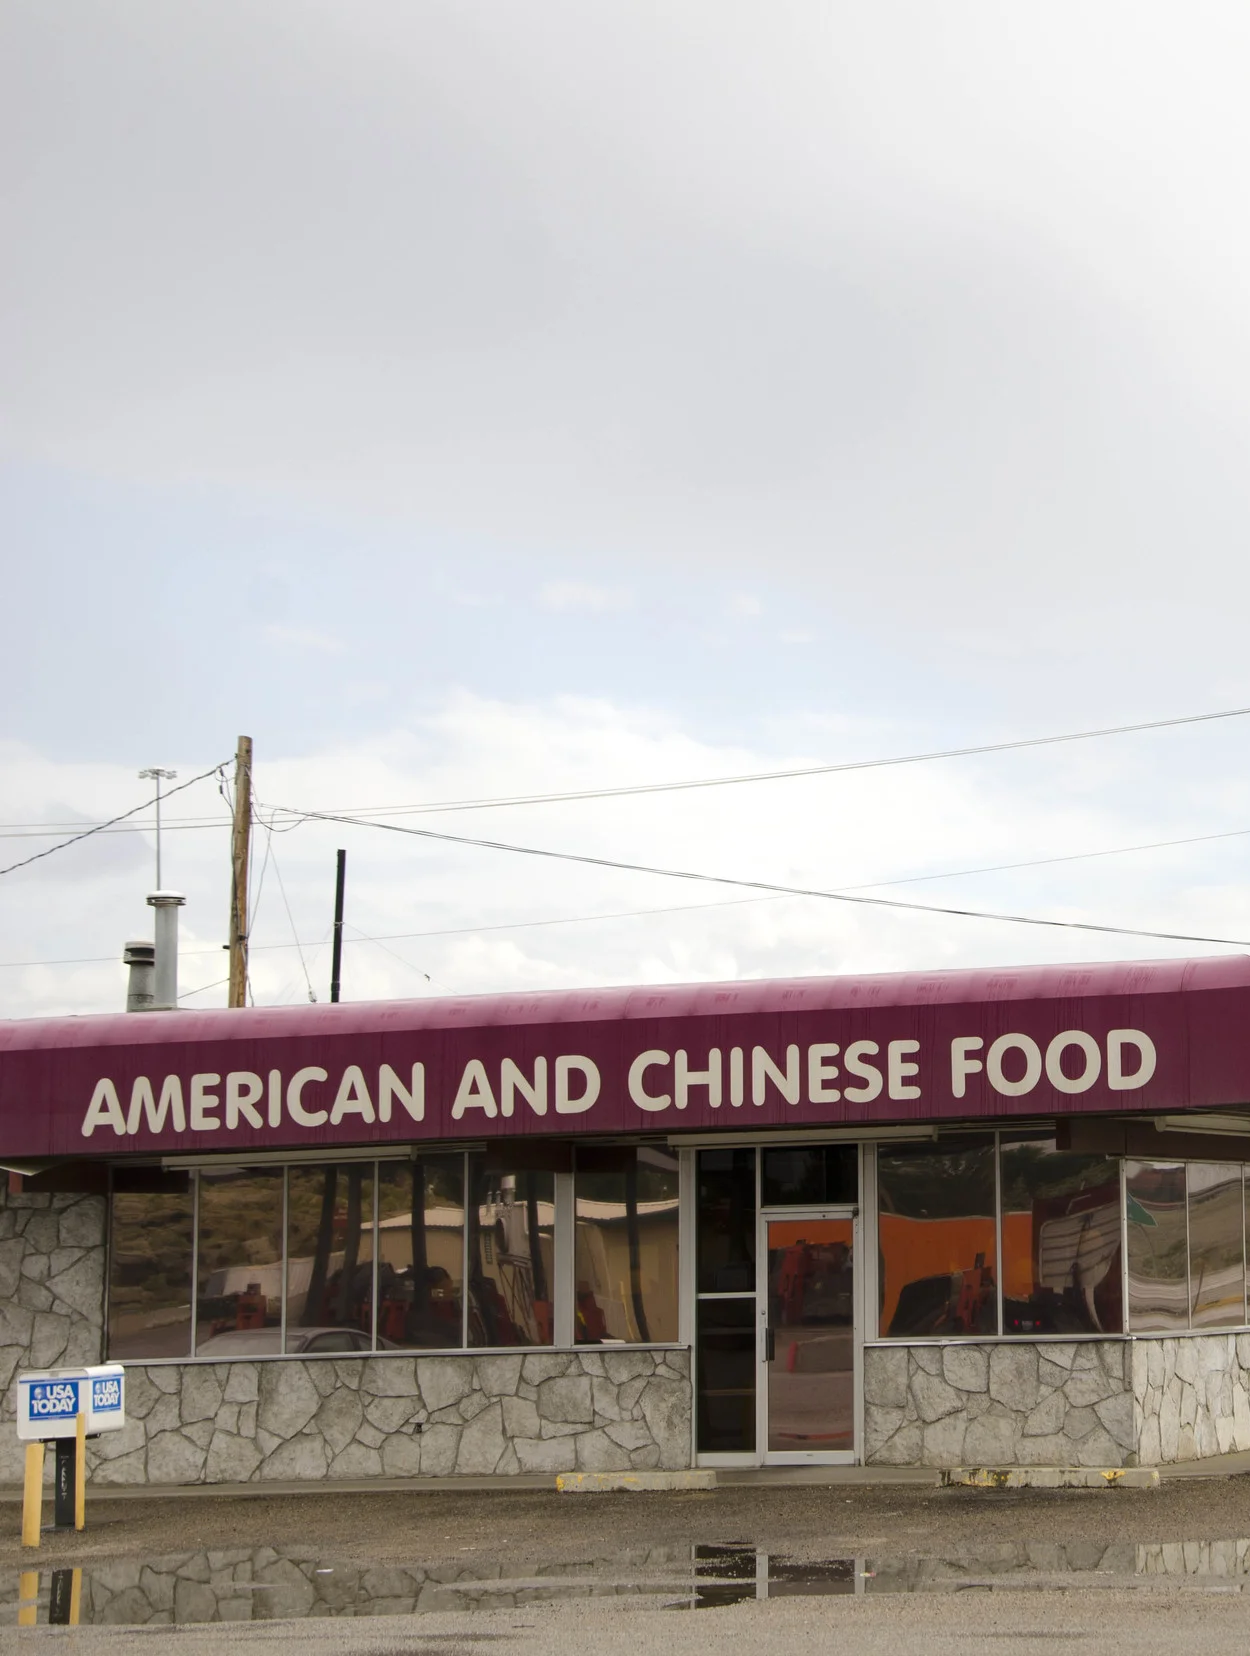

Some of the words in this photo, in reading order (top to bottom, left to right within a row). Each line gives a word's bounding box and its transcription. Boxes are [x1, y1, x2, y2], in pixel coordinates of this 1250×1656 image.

[82, 1062, 425, 1137] AMERICAN
[452, 1055, 601, 1120] AND
[628, 1039, 922, 1112] CHINESE
[951, 1028, 1157, 1098] FOOD
[45, 1384, 75, 1399] USA
[102, 1380, 119, 1393] USA
[32, 1397, 76, 1414] TODAY
[93, 1391, 120, 1407] TODAY
